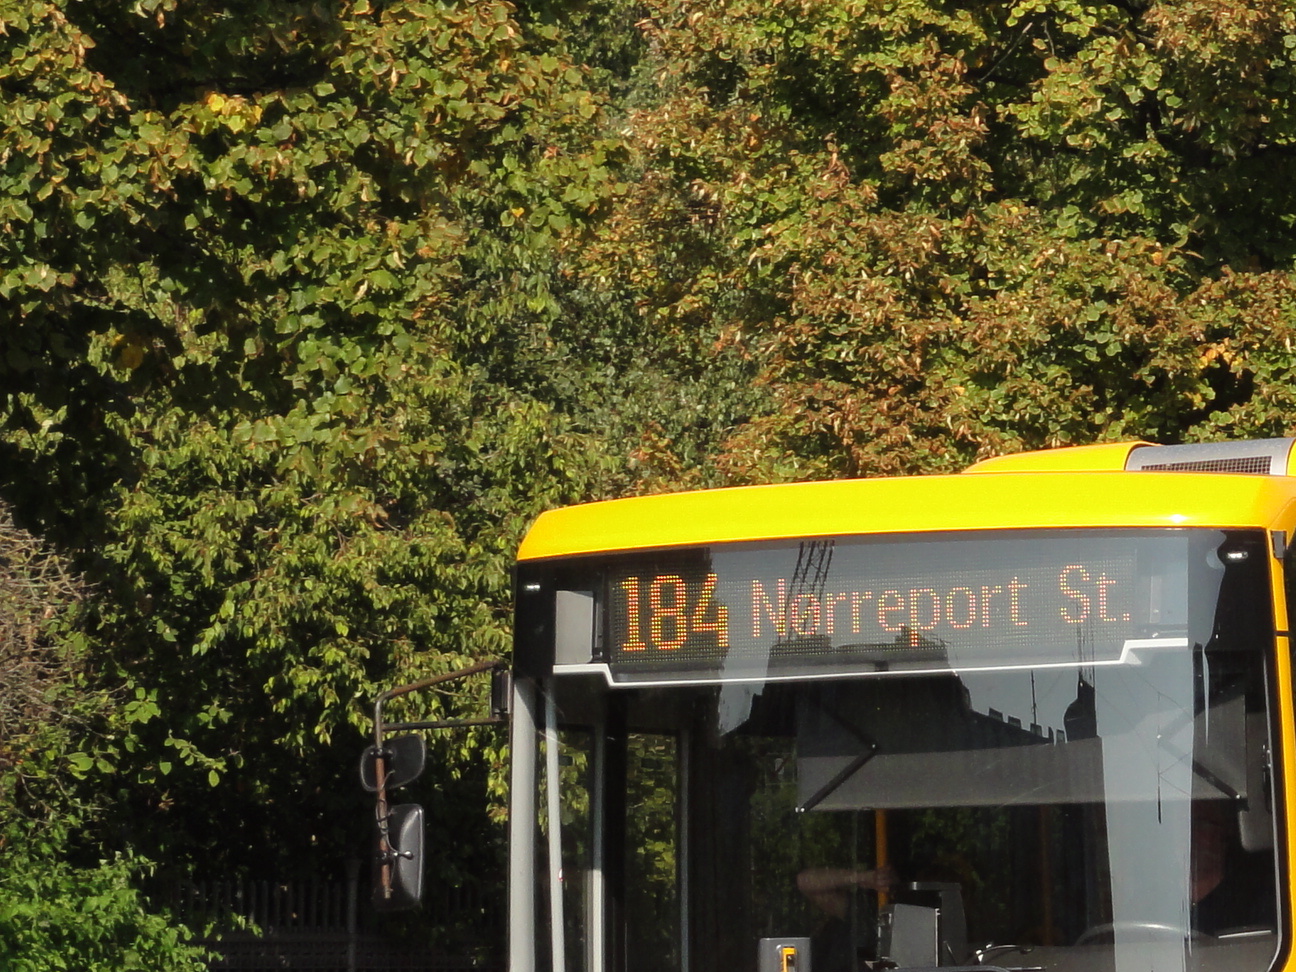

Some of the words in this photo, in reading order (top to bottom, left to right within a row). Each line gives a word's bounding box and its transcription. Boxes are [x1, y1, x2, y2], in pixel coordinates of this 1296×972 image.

[621, 573, 729, 651] 184
[752, 576, 1028, 647] Nørreport
[1060, 564, 1131, 624] St.
